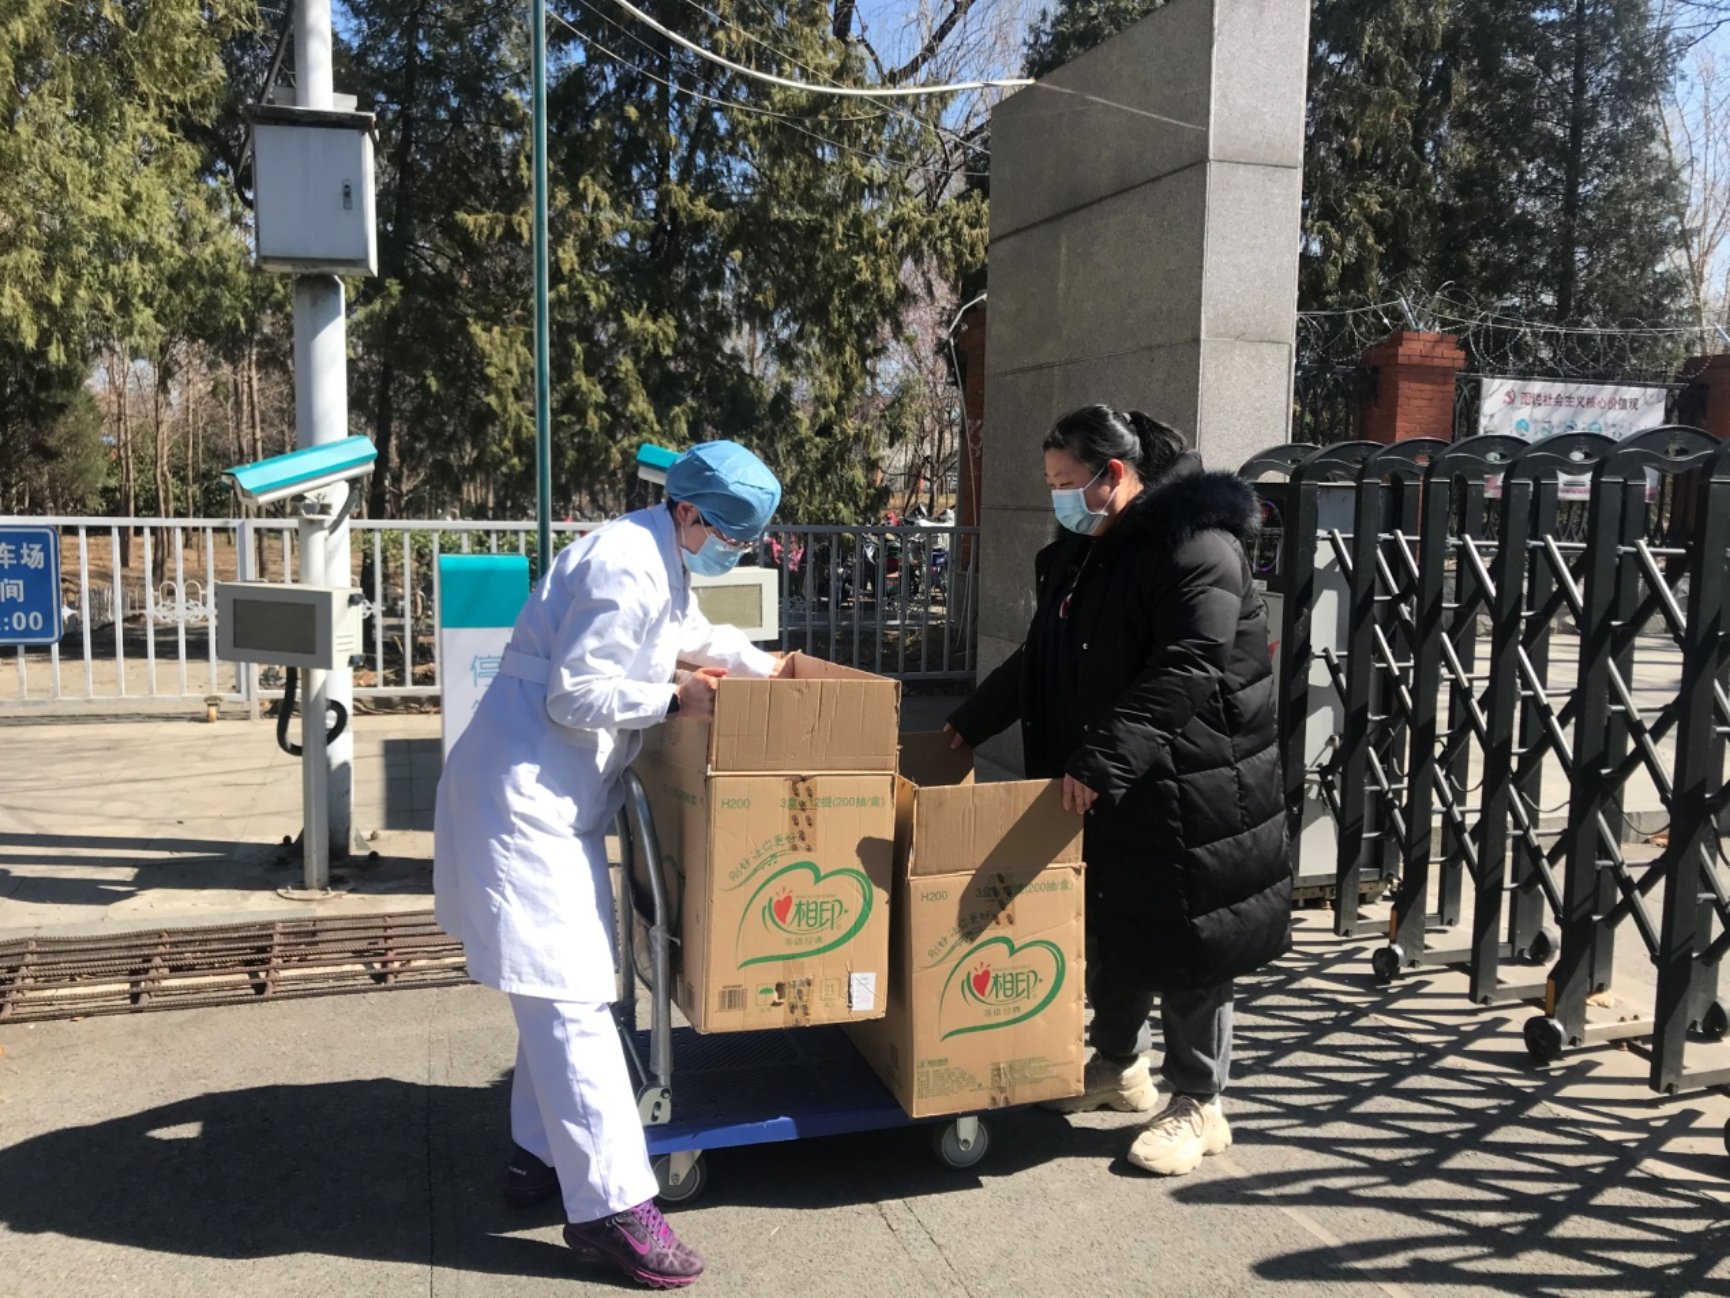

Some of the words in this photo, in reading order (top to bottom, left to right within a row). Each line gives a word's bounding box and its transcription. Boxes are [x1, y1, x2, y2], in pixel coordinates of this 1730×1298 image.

[0, 578, 24, 602] 间
[0, 611, 43, 631] :00
[721, 799, 751, 809] H200
[921, 891, 948, 902] H200
[762, 892, 845, 935] 心相印
[961, 968, 1040, 1006] 心相印
